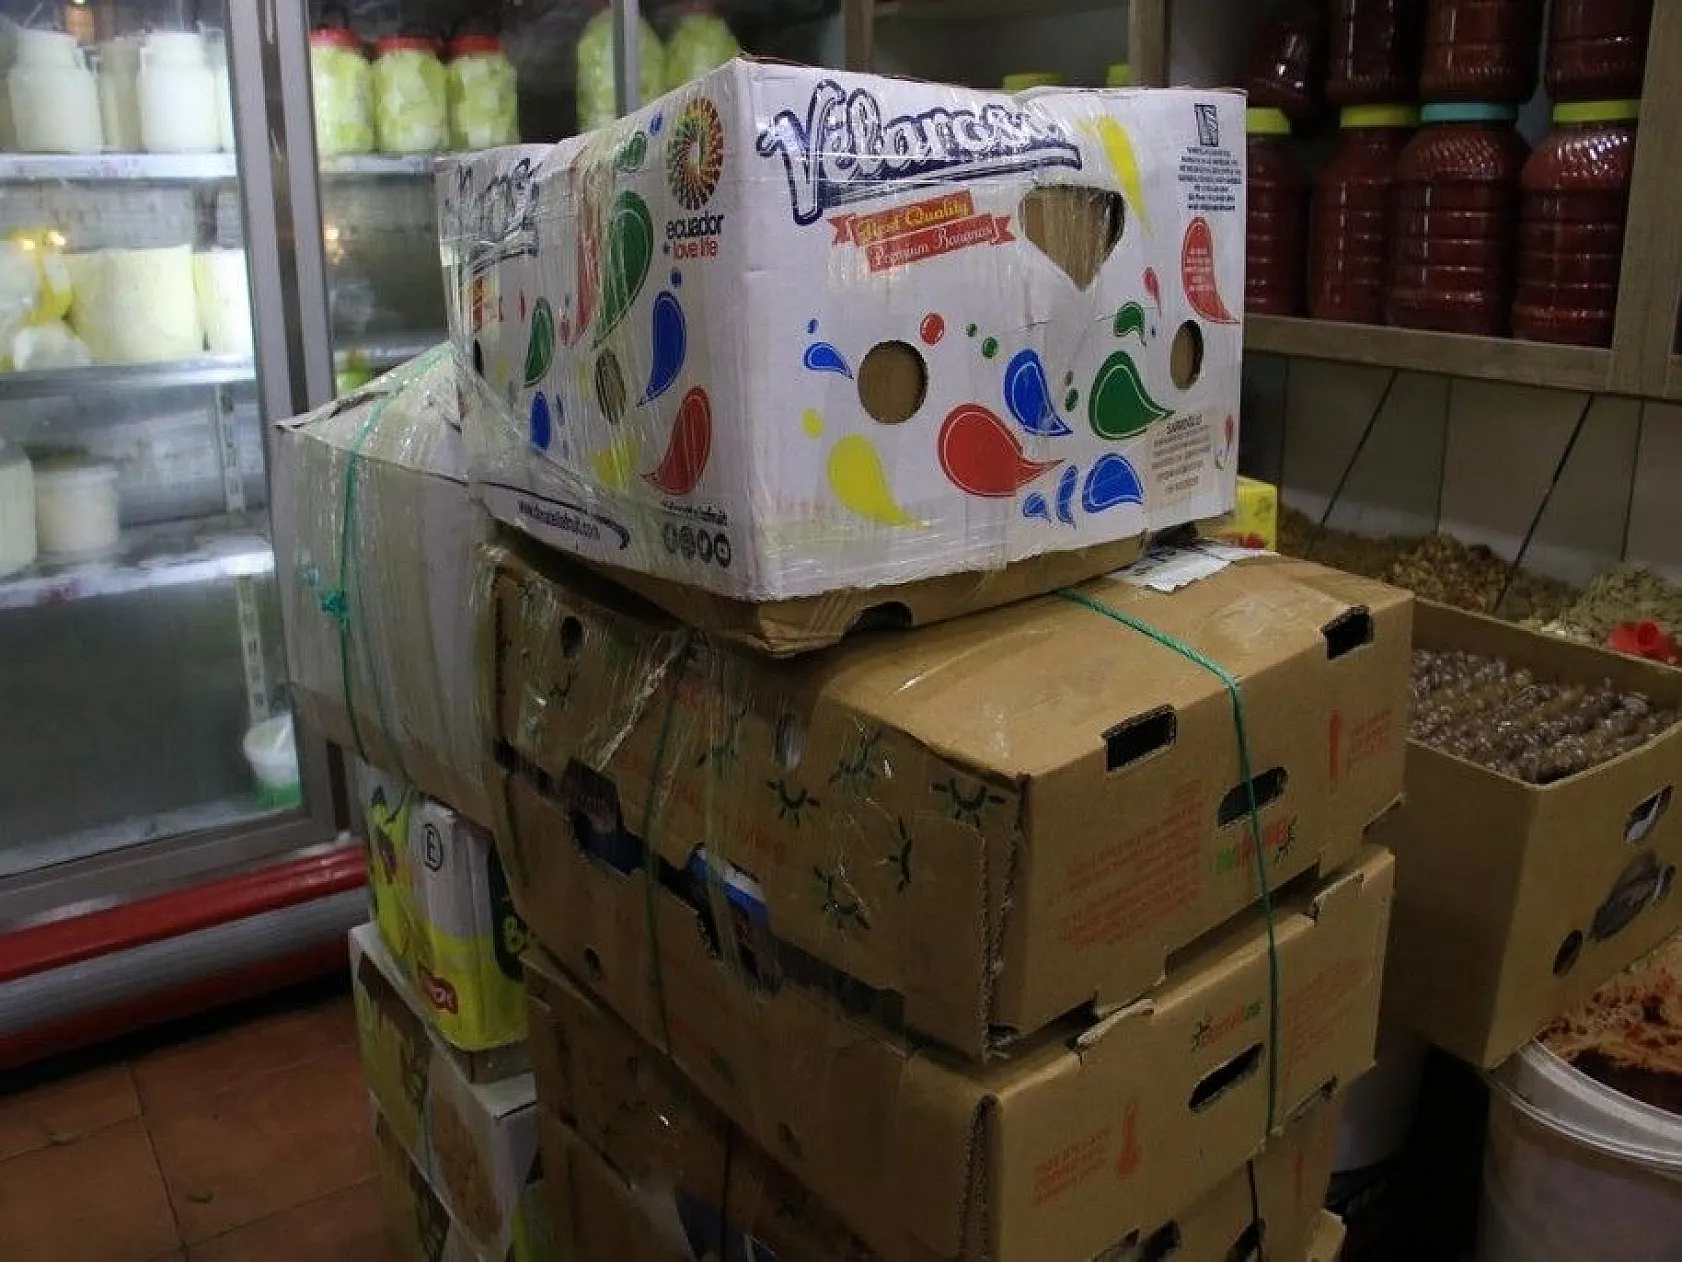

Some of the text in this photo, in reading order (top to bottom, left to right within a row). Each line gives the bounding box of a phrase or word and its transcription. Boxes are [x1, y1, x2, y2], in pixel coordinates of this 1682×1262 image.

[666, 209, 725, 240] ecuador
[905, 198, 972, 229] Quality
[673, 236, 719, 260] love life
